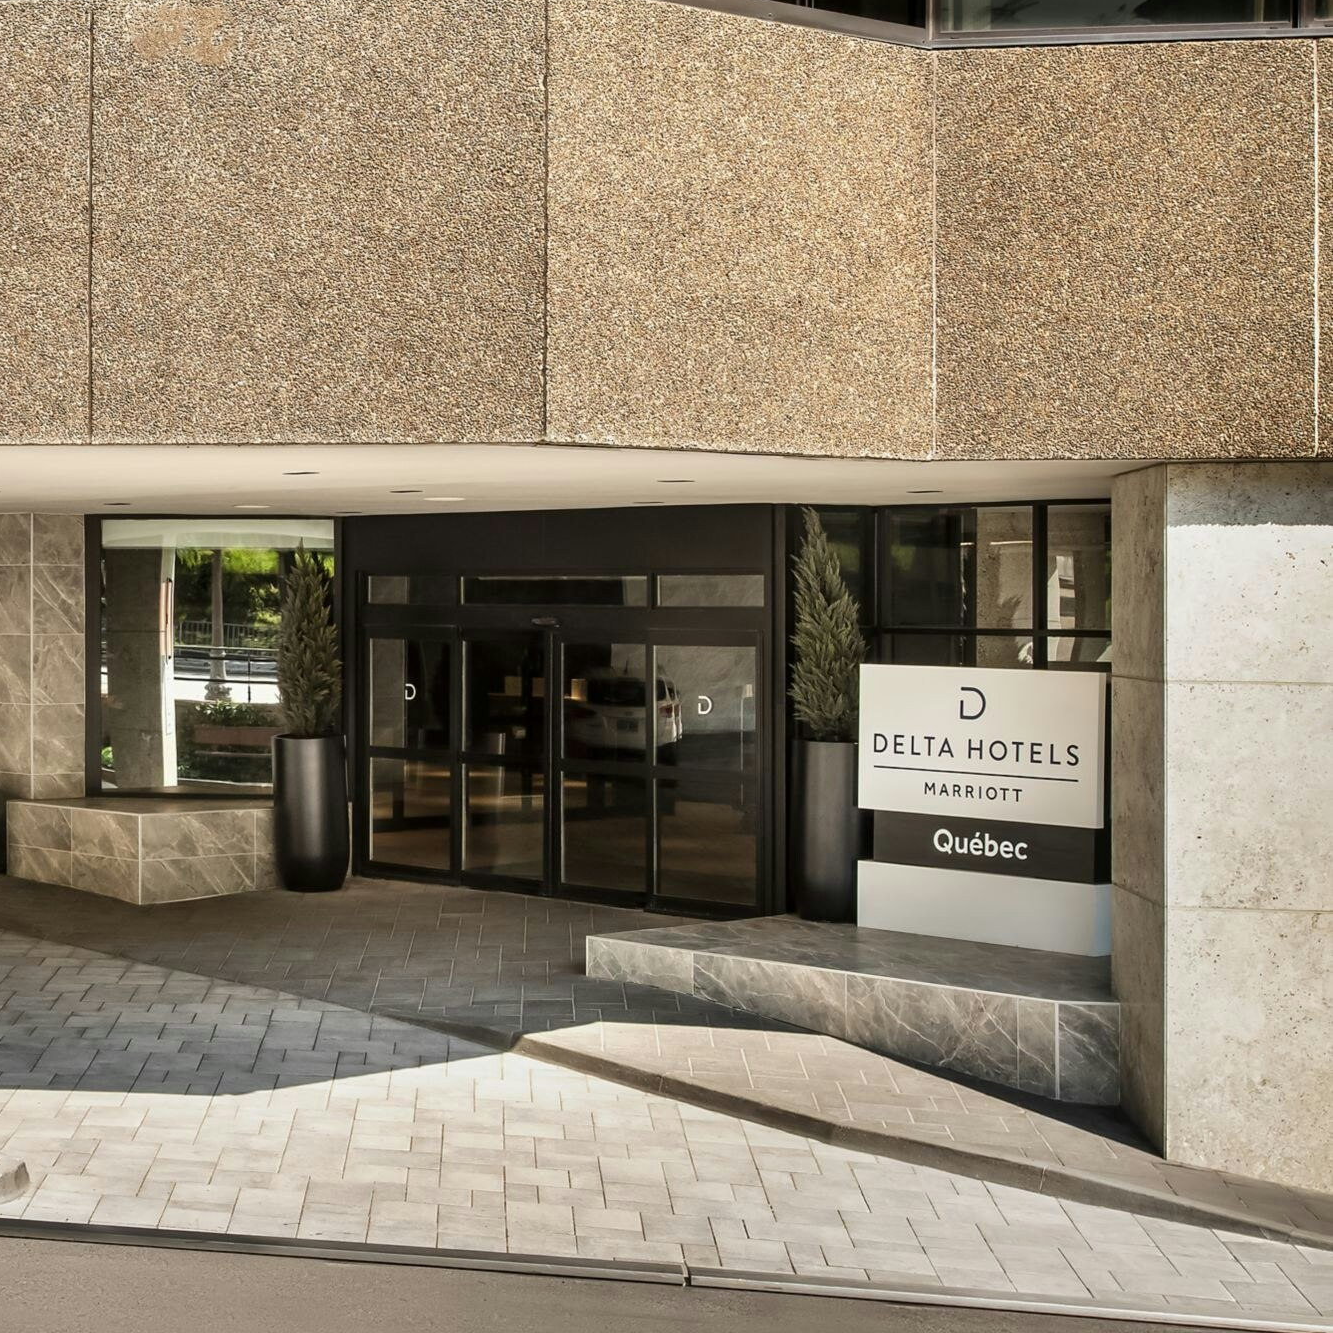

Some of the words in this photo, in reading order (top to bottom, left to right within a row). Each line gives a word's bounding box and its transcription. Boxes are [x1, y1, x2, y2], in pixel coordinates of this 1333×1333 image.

[405, 683, 417, 701] D
[697, 695, 713, 715] D
[959, 686, 987, 721] D
[873, 733, 955, 758] DELTA
[967, 738, 1080, 767] HOTELS
[924, 781, 1023, 803] MARRIOTT
[932, 828, 1028, 860] Québec
